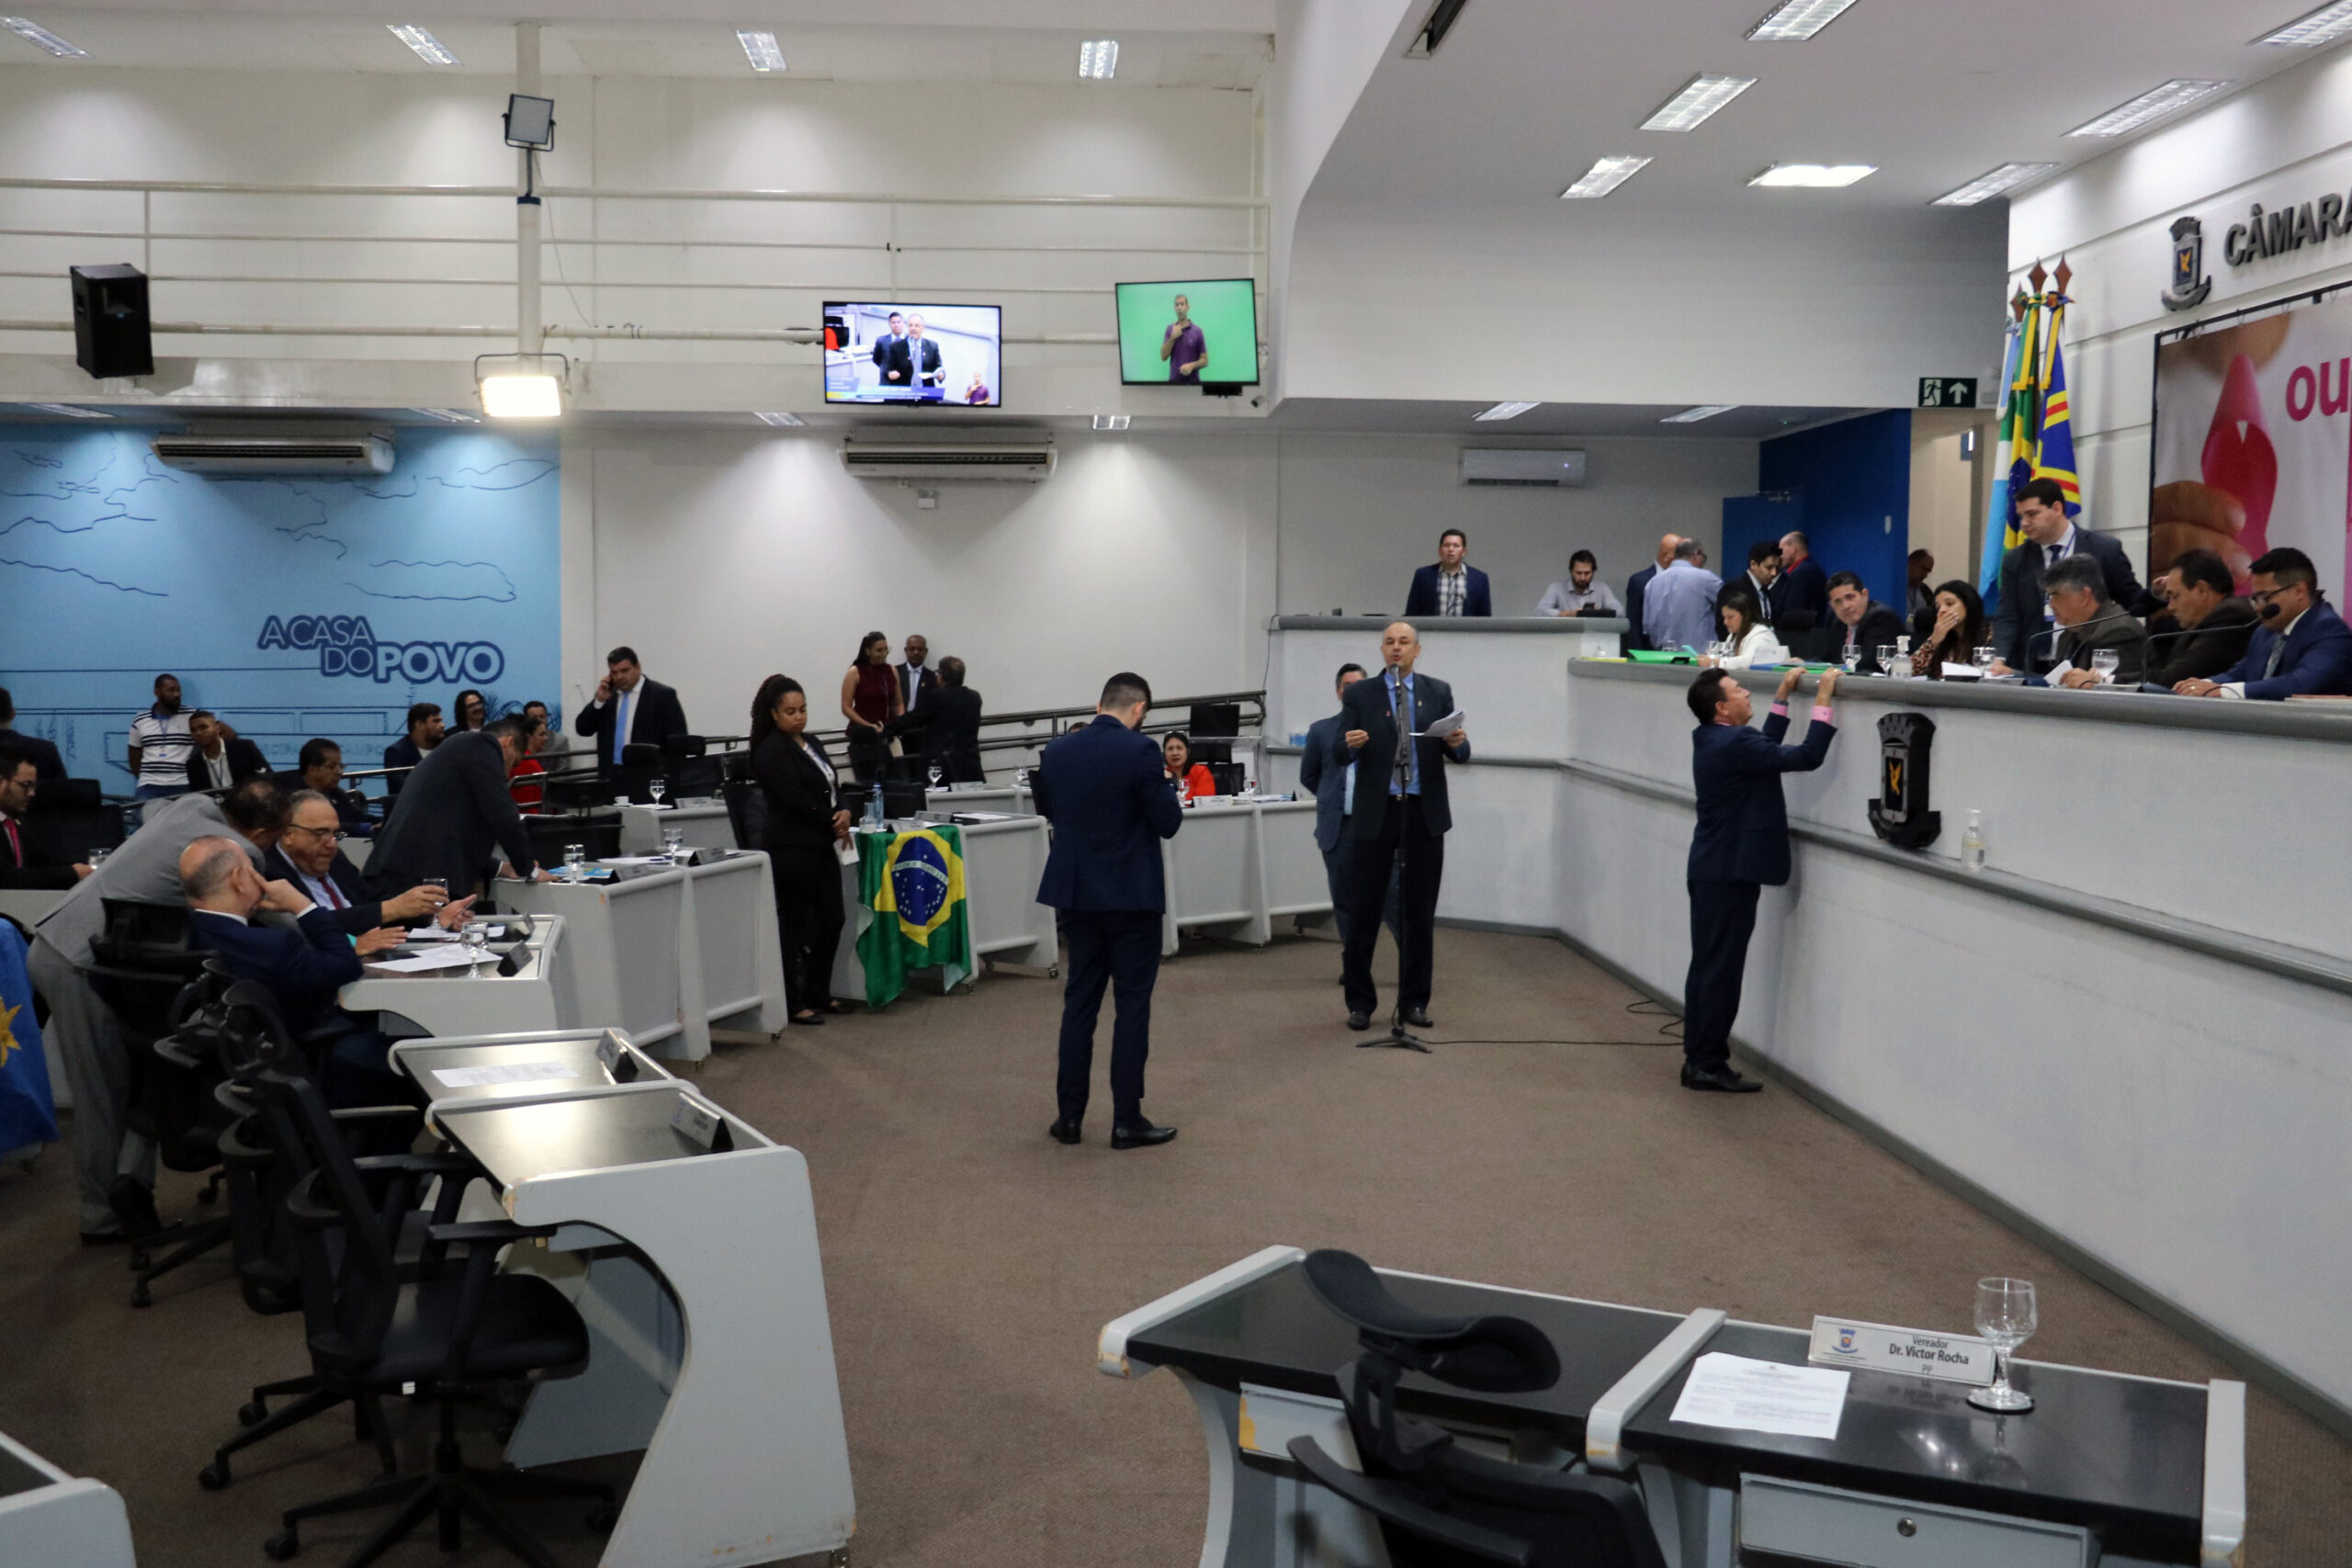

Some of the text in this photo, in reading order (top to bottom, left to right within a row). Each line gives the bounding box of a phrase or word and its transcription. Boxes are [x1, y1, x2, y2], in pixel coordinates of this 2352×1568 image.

[323, 644, 502, 682] DO POVO
[1912, 1334, 1949, 1349] Vereador
[1889, 1343, 1970, 1365] Dr. Victor Rocha
[1921, 1364, 1933, 1375] PP
